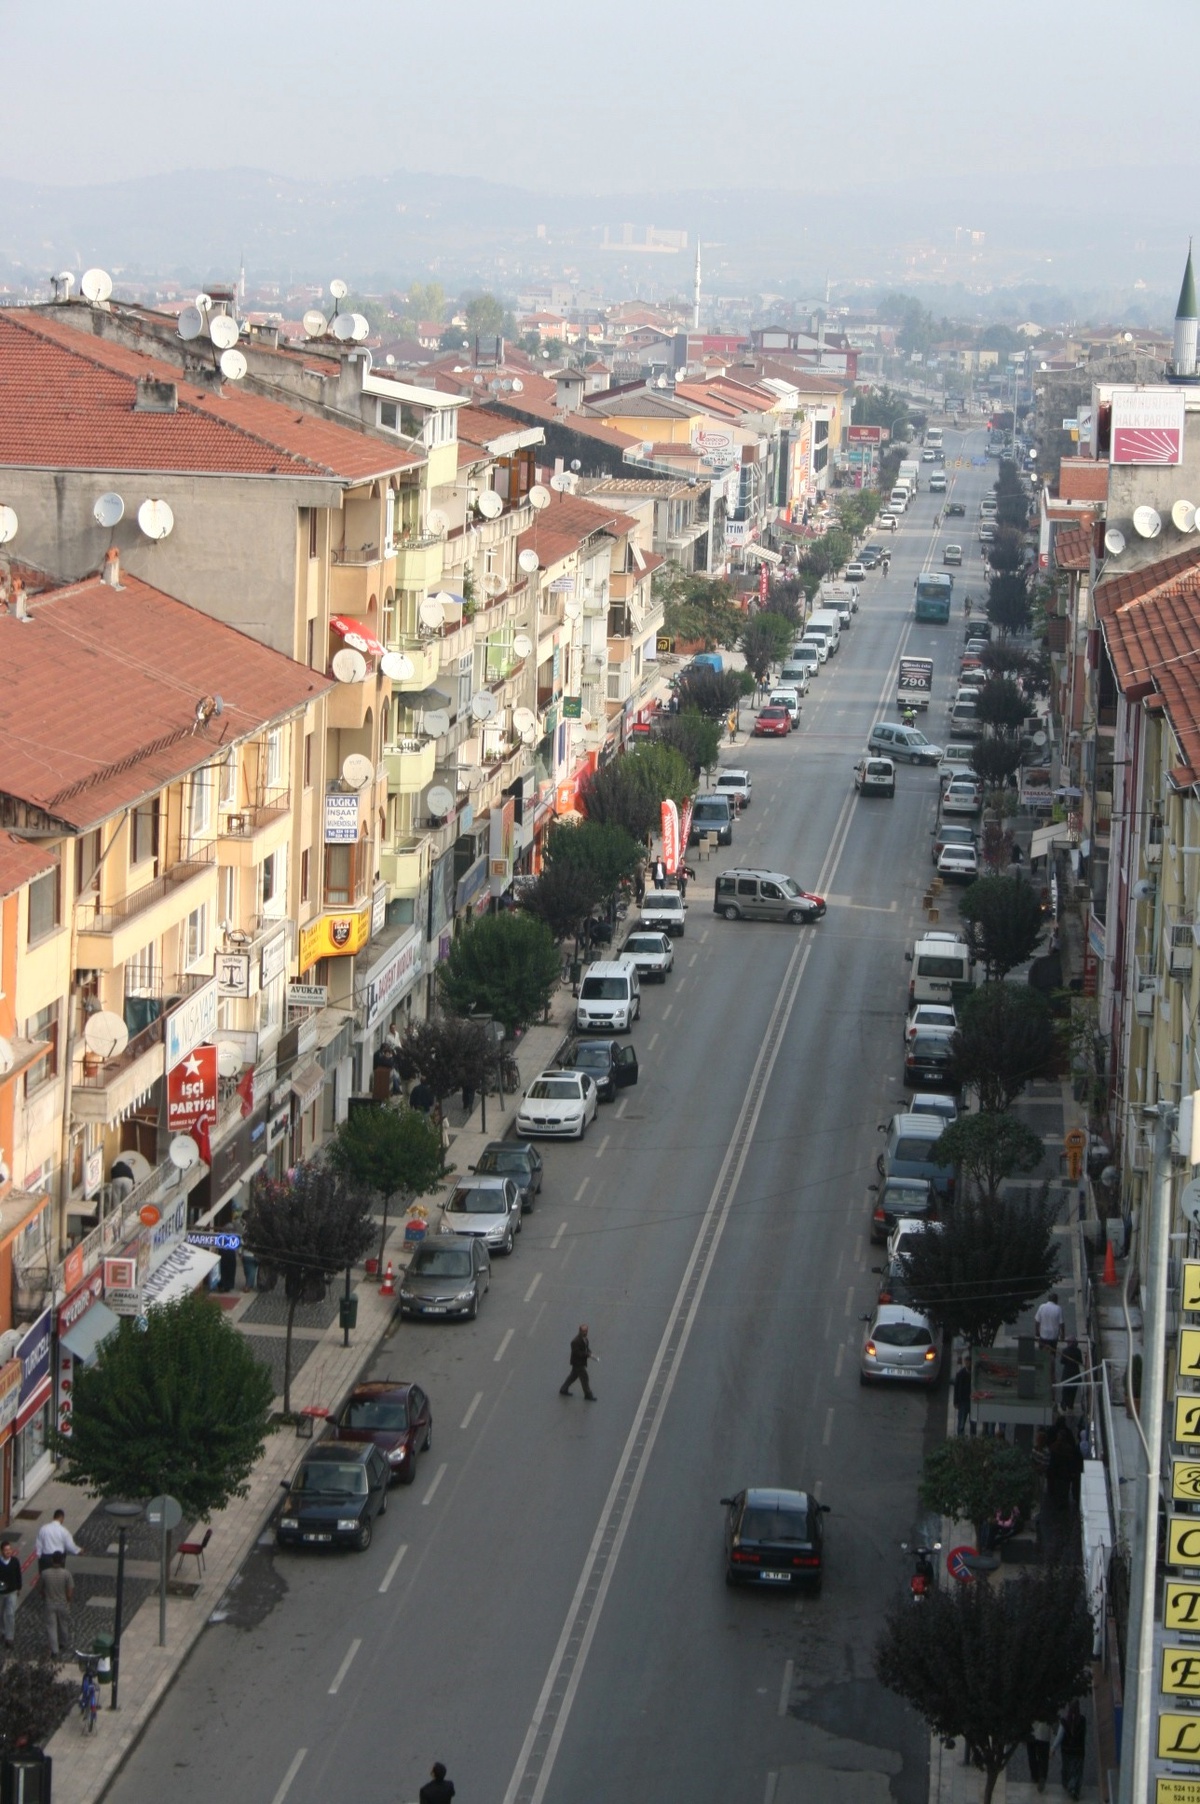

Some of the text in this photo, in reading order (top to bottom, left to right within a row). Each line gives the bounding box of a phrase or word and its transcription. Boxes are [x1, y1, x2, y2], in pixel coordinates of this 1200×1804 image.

[901, 677, 926, 687] 790
[327, 797, 358, 807] TUĞRA
[291, 985, 324, 994] AVUKAT
[181, 1079, 204, 1098] İŞÇİ
[170, 1096, 216, 1115] PARTİSİ
[111, 1265, 128, 1283] E
[1160, 1783, 1171, 1791] Tel.
